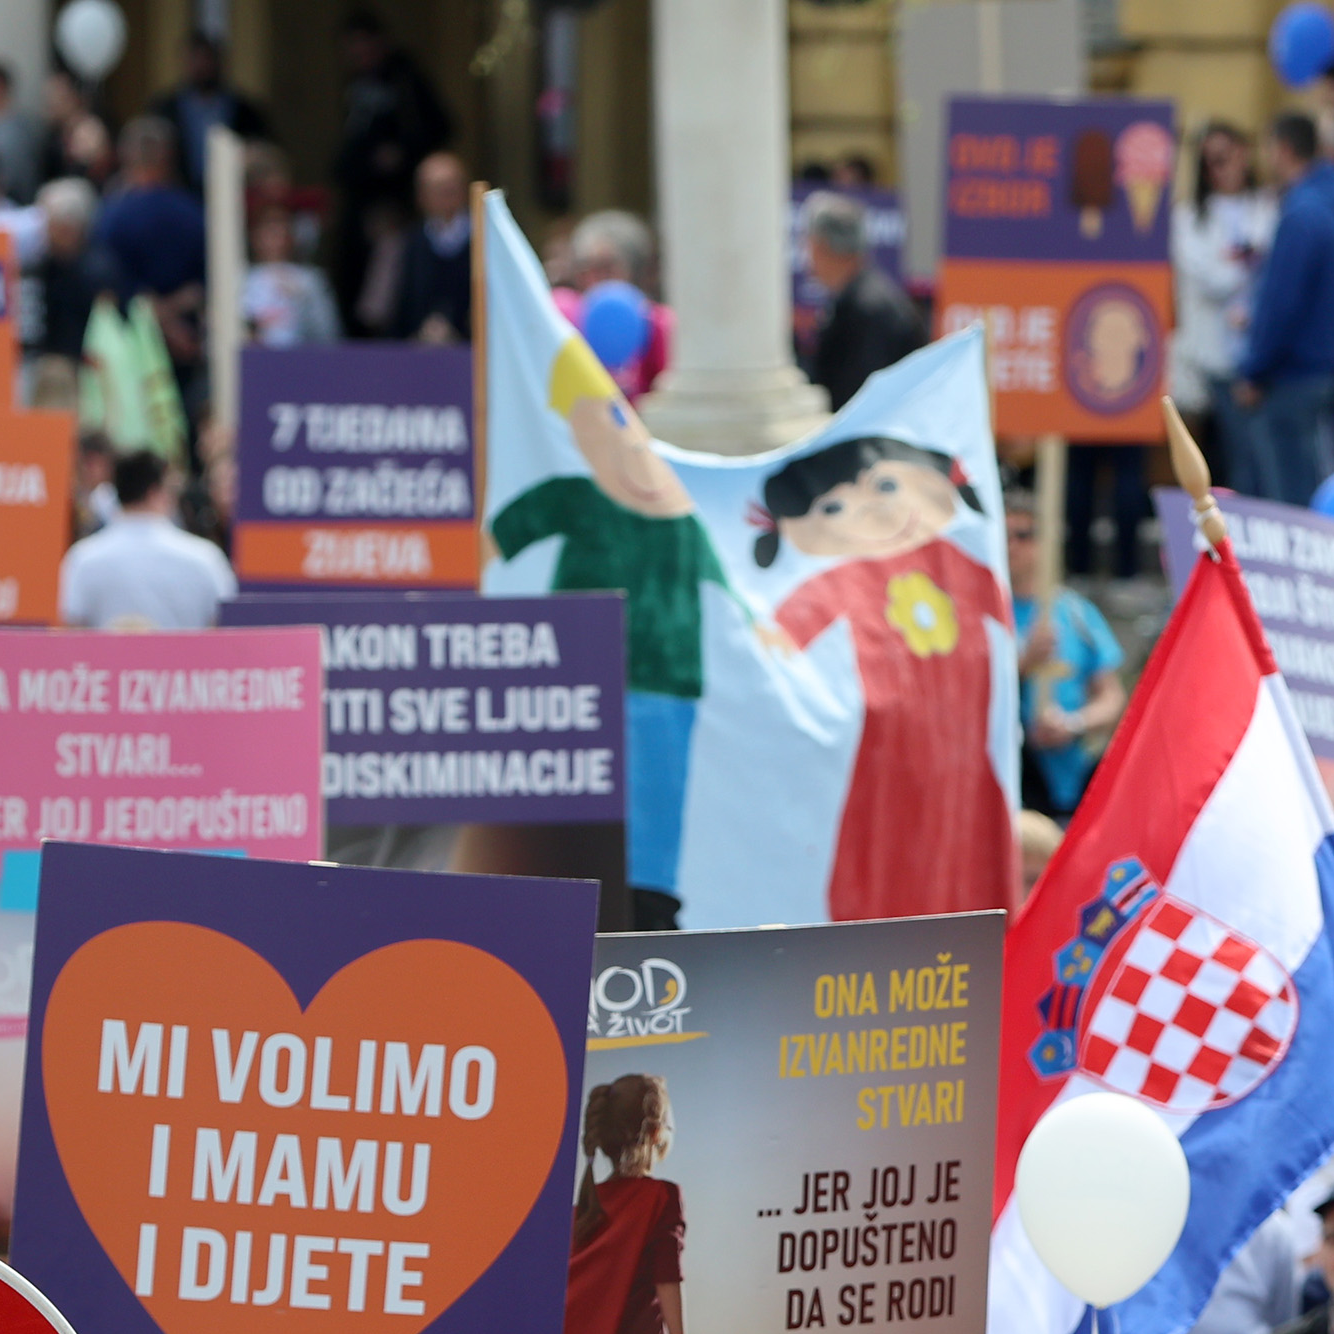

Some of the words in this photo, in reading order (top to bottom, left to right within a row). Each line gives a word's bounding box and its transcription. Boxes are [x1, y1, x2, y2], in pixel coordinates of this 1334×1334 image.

[268, 403, 301, 452] 7
[303, 405, 468, 455] TJEDANA
[263, 467, 321, 515] OD
[322, 461, 472, 517] ZAČEĆA
[423, 623, 559, 669] TREBA
[18, 660, 112, 715] MOŽE
[118, 666, 305, 713] IZVANREDNE
[389, 688, 471, 735] SVE
[476, 685, 601, 732] LJUDE
[321, 749, 614, 799] DISKIMINACIJE
[39, 796, 92, 840] JOJ
[814, 972, 878, 1018] ONA
[888, 952, 970, 1013] MOŽE
[606, 1007, 692, 1037] ŽIVOT
[97, 1018, 188, 1098] MI
[212, 1028, 497, 1120] VOLIMO
[778, 1022, 967, 1079] IZVANREDNE
[857, 1079, 964, 1130] STVARI
[148, 1123, 170, 1198] I
[191, 1127, 431, 1216] MAMU
[794, 1170, 851, 1215] JER
[862, 1164, 916, 1210] JOJ
[927, 1160, 961, 1204] JE
[135, 1223, 158, 1297] I
[178, 1226, 430, 1315] DIJETE
[777, 1212, 957, 1274] DOPUŠTENO
[786, 1288, 826, 1330] DA
[837, 1282, 876, 1326] SE
[886, 1275, 955, 1323] RODI
